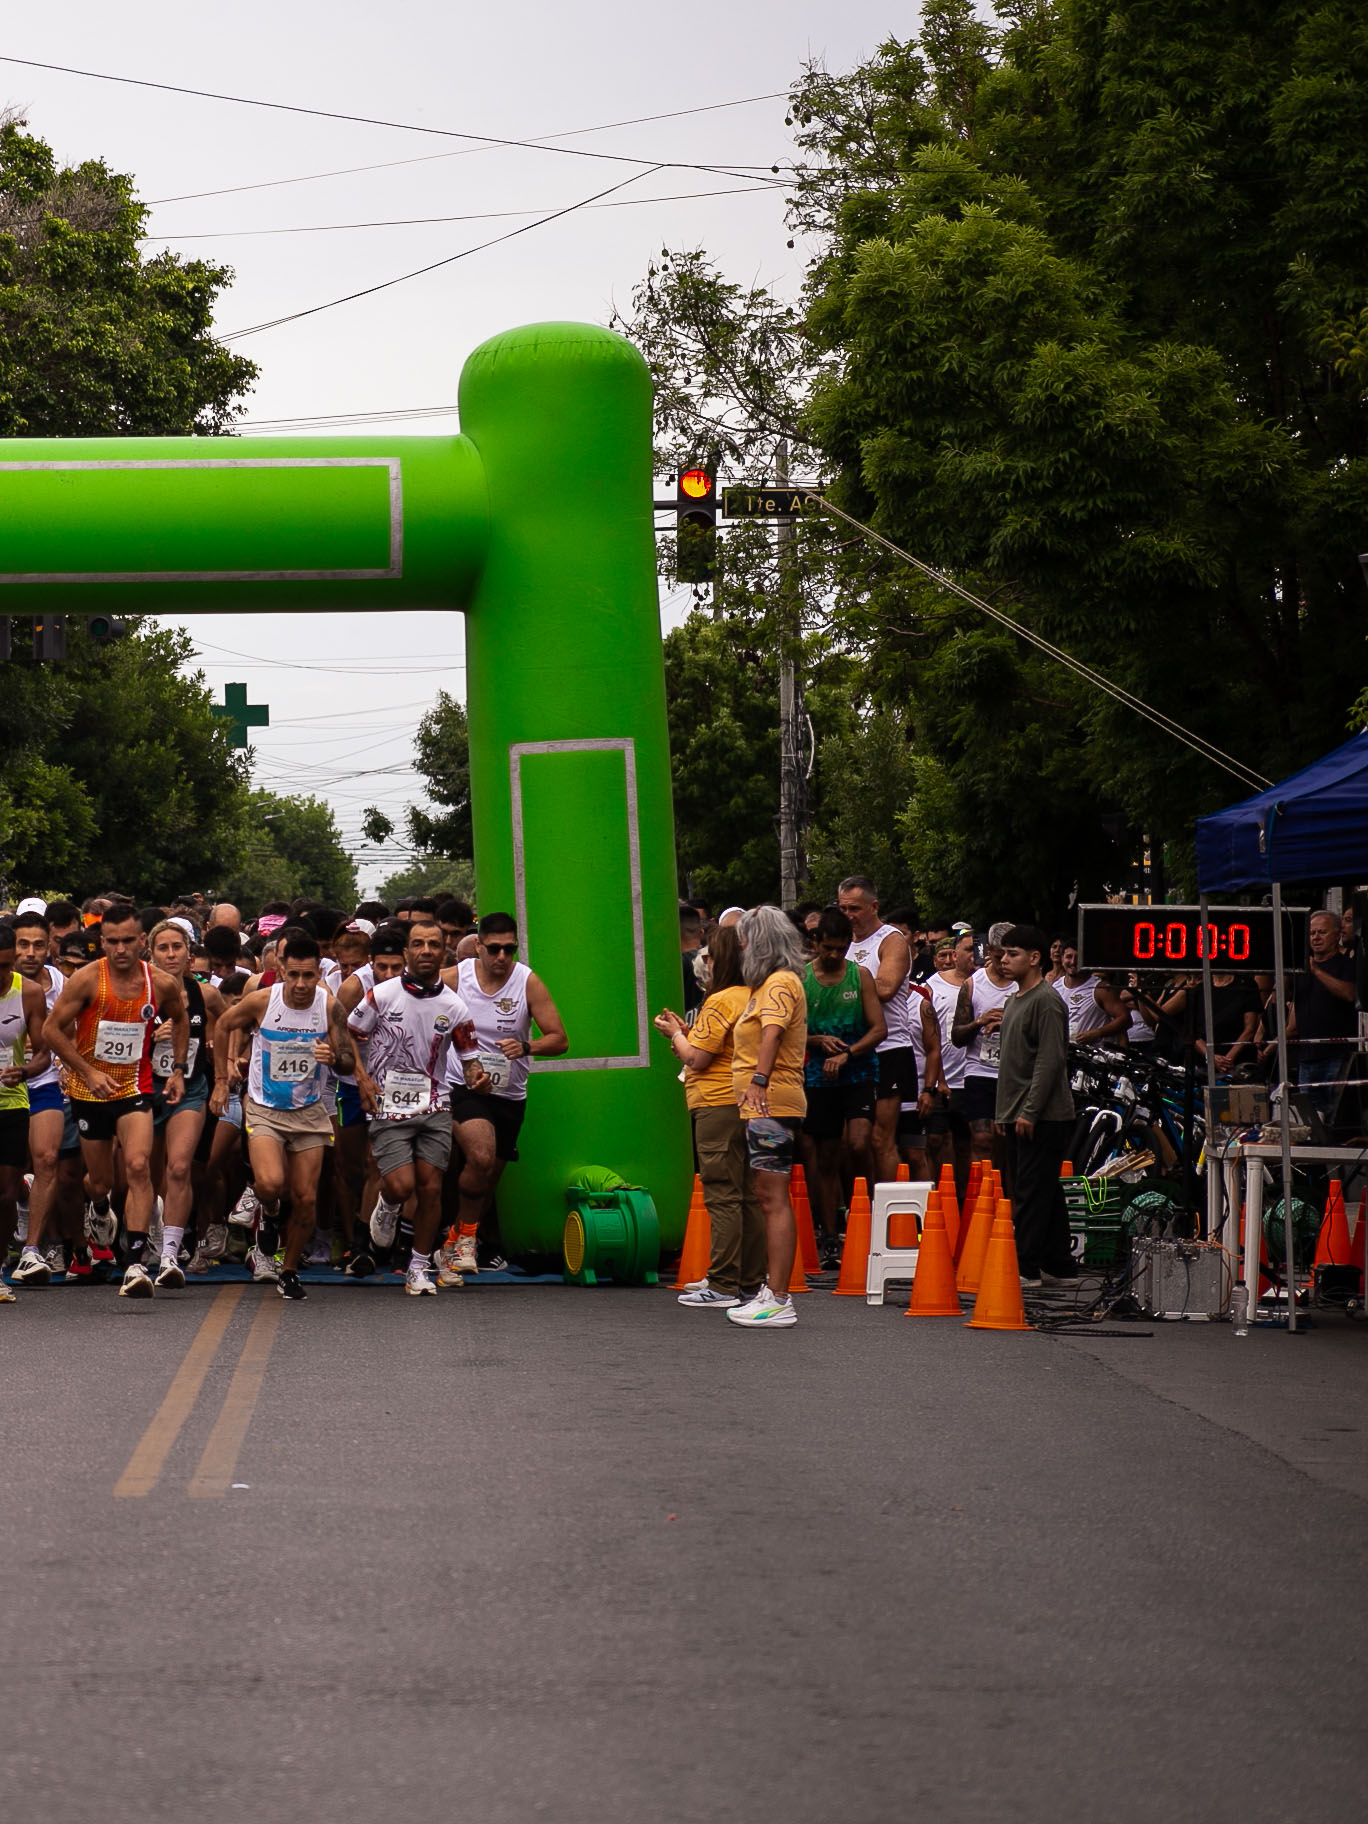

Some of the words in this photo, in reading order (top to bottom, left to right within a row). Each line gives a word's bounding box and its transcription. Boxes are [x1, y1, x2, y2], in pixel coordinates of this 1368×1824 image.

[843, 991, 857, 1000] CM
[104, 1041, 133, 1057] 291
[278, 1060, 309, 1073] 416
[392, 1091, 420, 1105] 644
